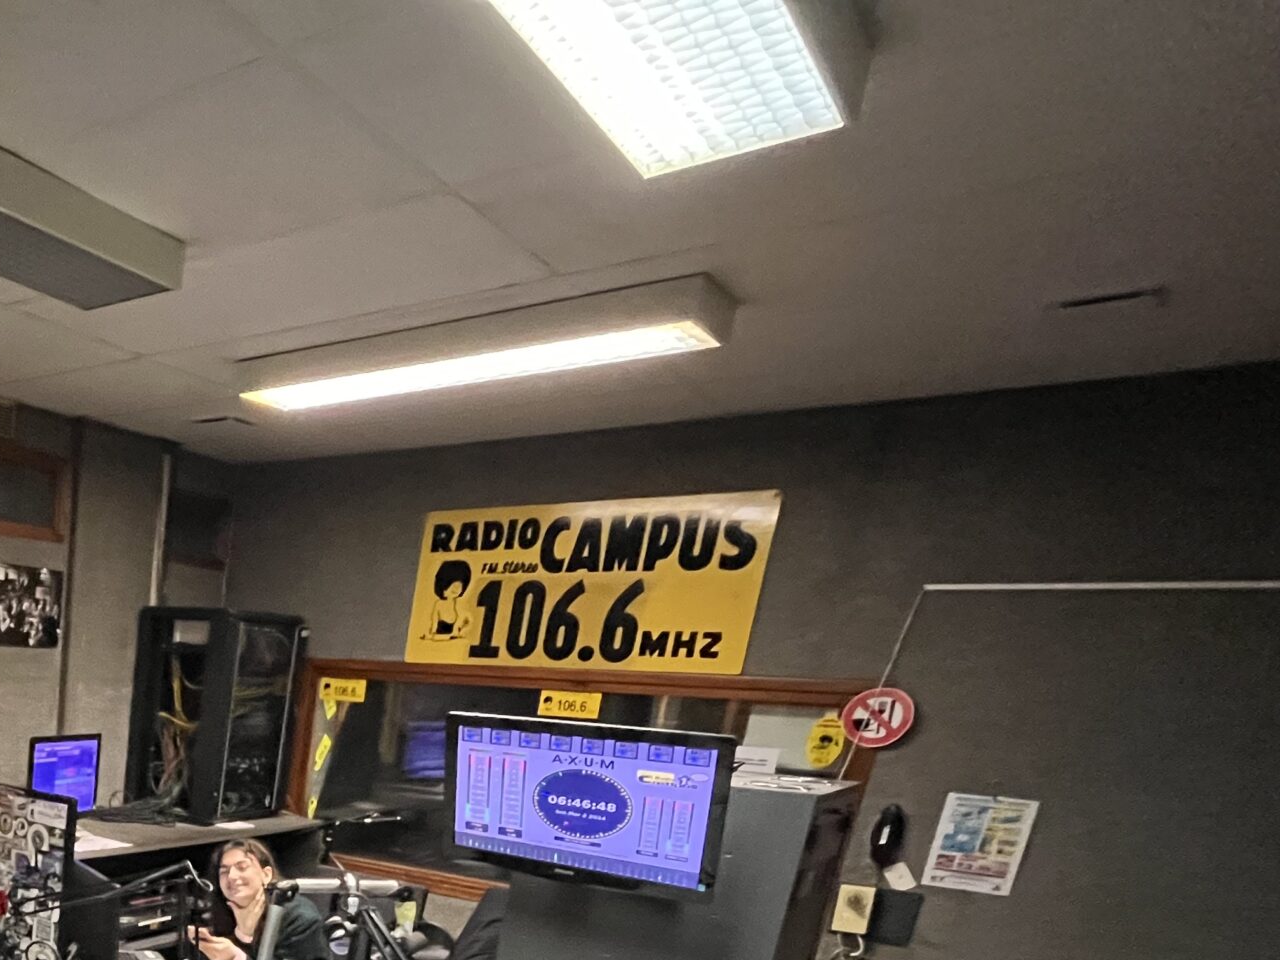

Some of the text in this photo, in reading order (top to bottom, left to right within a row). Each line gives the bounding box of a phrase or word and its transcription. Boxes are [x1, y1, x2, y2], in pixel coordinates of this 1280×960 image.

[429, 512, 759, 574] RADIO CAMPUS
[468, 577, 723, 664] 106.6 MHZ
[557, 698, 588, 713] 106.6
[547, 794, 617, 813] 06:46:48
